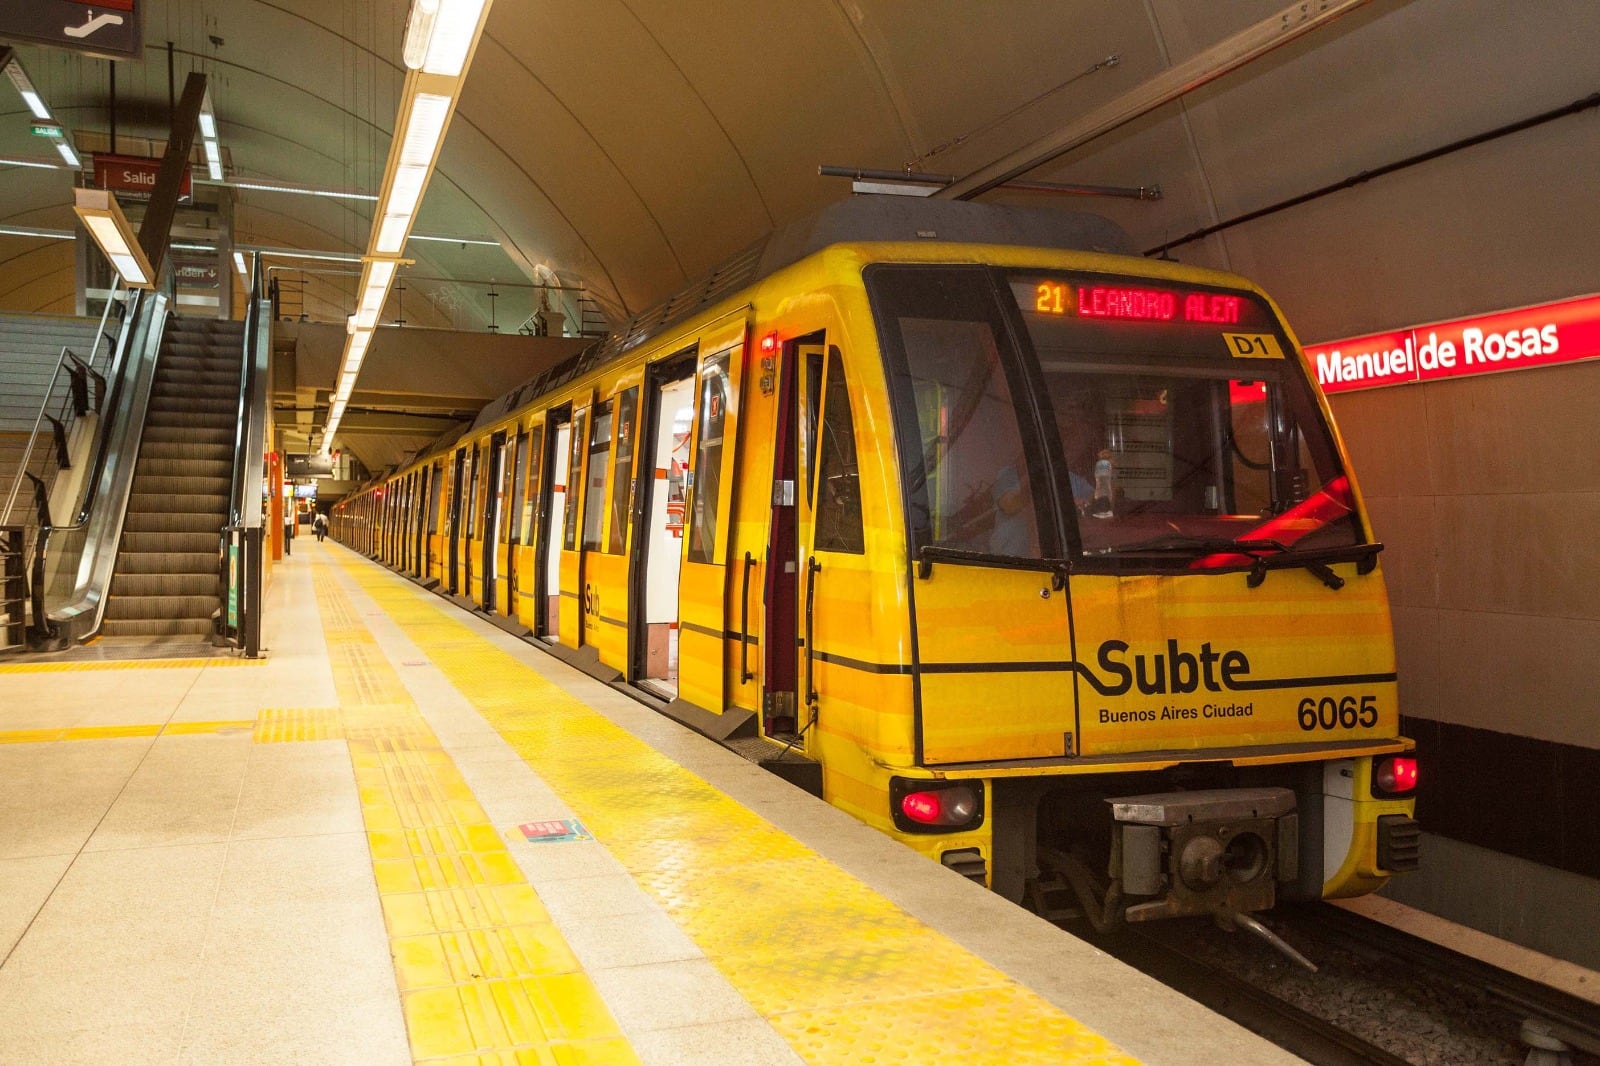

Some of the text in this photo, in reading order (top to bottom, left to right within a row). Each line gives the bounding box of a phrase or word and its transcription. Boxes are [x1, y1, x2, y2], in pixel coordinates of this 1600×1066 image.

[122, 170, 157, 185] Salid
[1037, 284, 1239, 323] 21 LEANDRO ALEM
[1232, 337, 1269, 355] D1
[1316, 324, 1559, 384] Manuel de Rosas
[585, 583, 600, 617] Sub
[1097, 639, 1250, 696] Subte
[1099, 703, 1253, 723] Buenos Aires Ciudad
[1297, 696, 1378, 731] 6065
